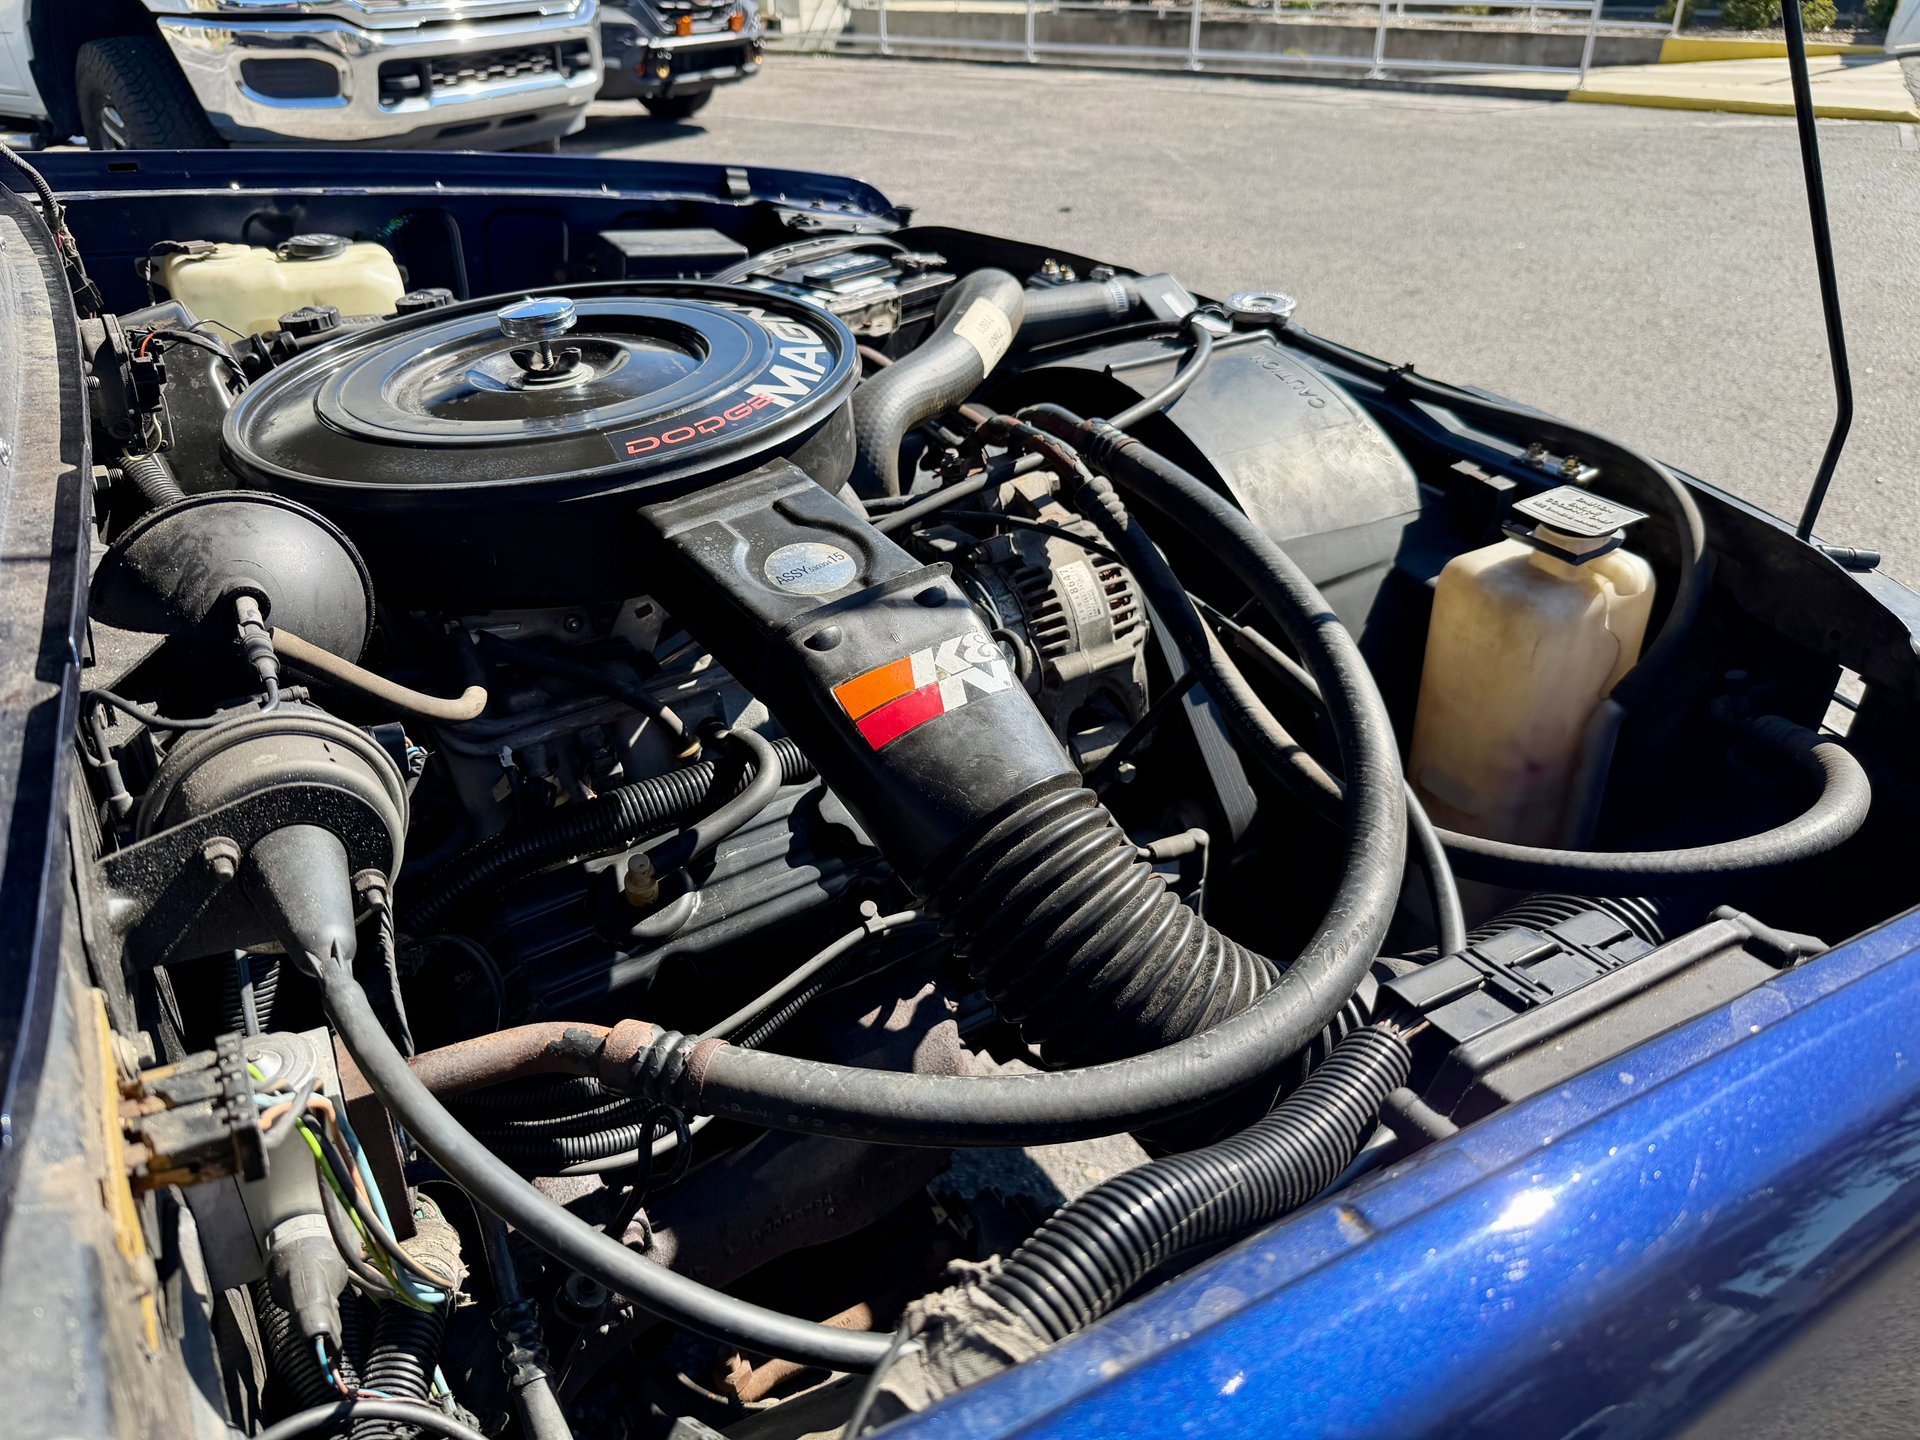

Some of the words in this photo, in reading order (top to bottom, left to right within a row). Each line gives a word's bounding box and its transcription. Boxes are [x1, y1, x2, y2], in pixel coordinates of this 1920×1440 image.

[1249, 354, 1326, 409] CAUTION
[625, 392, 776, 455] DODGE
[775, 565, 809, 586] ASSY
[1059, 569, 1079, 595] 8647
[910, 631, 1014, 713] K&N
